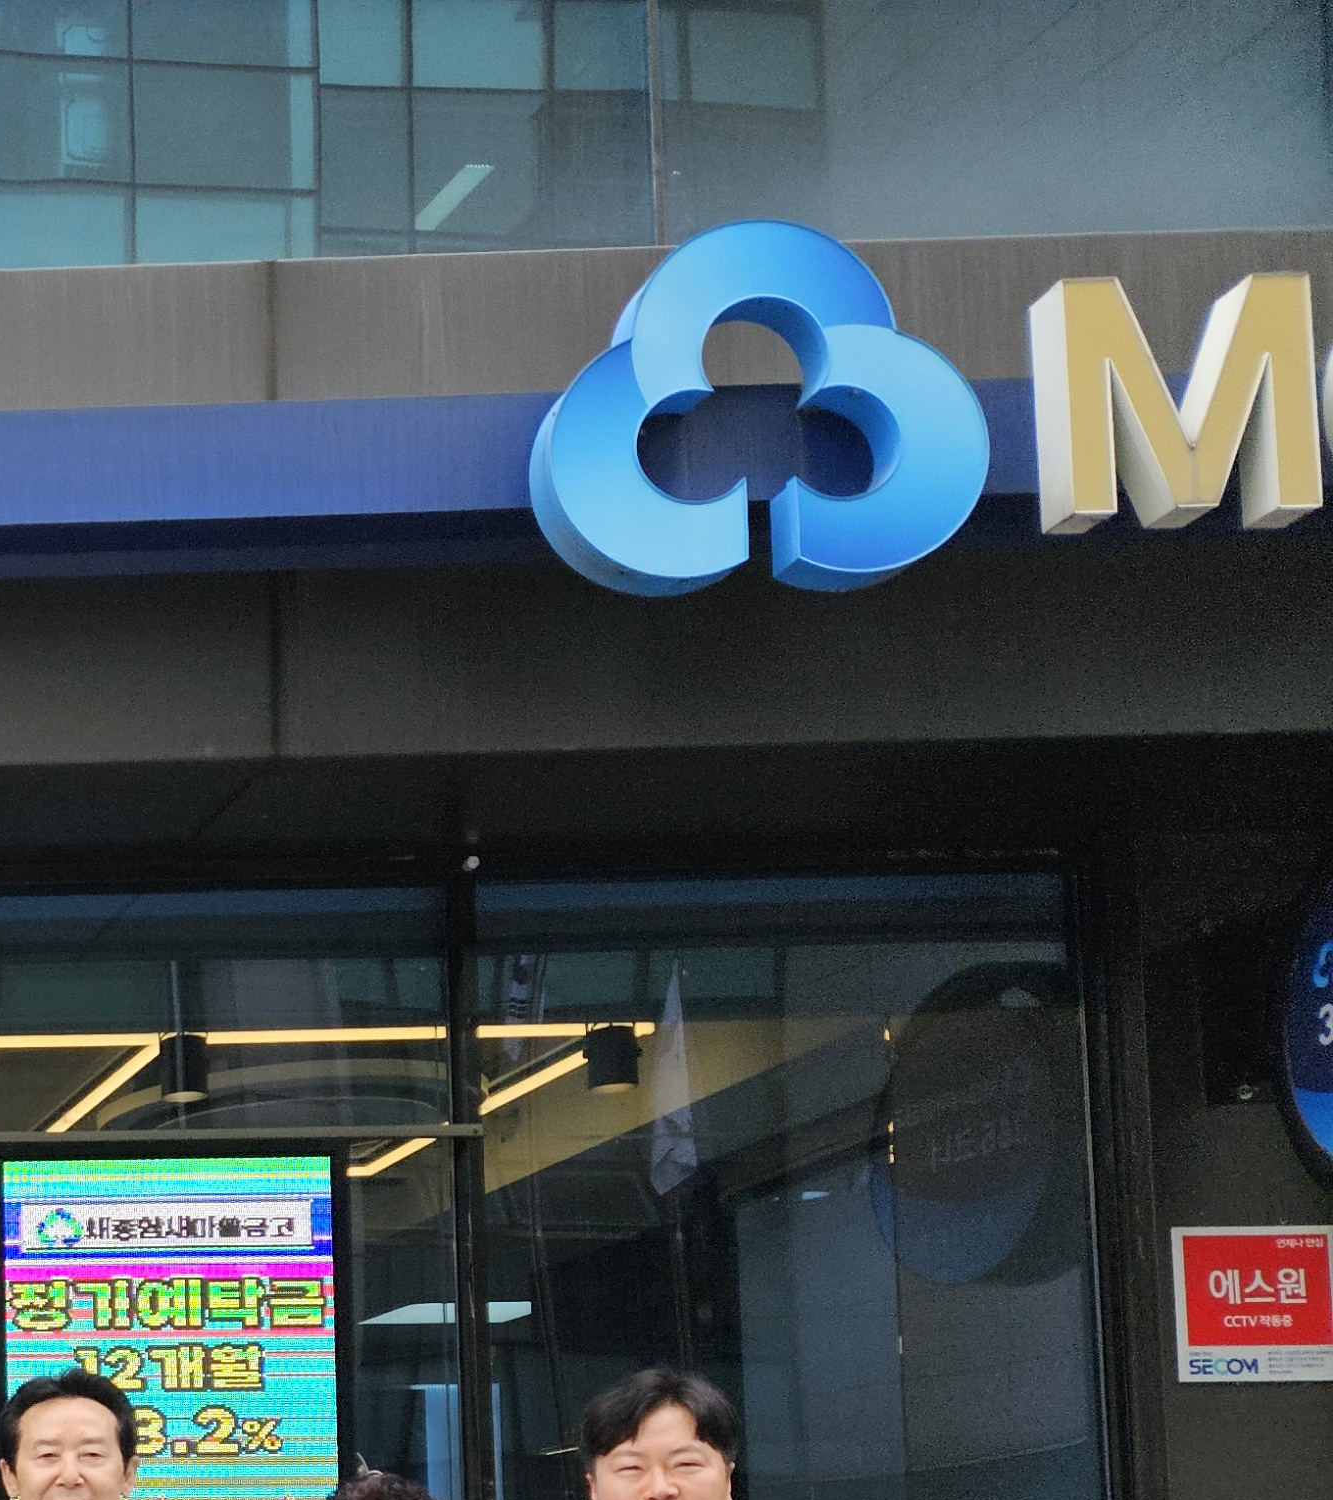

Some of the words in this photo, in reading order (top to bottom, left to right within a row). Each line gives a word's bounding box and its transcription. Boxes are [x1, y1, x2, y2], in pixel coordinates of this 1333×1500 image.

[1028, 270, 1333, 534] M
[10, 1276, 325, 1331] 정기예탁금
[1209, 1268, 1308, 1305] 에스원
[1224, 1315, 1257, 1327] CCTV
[74, 1342, 266, 1391] 12개월
[1189, 1358, 1259, 1375] SECOM
